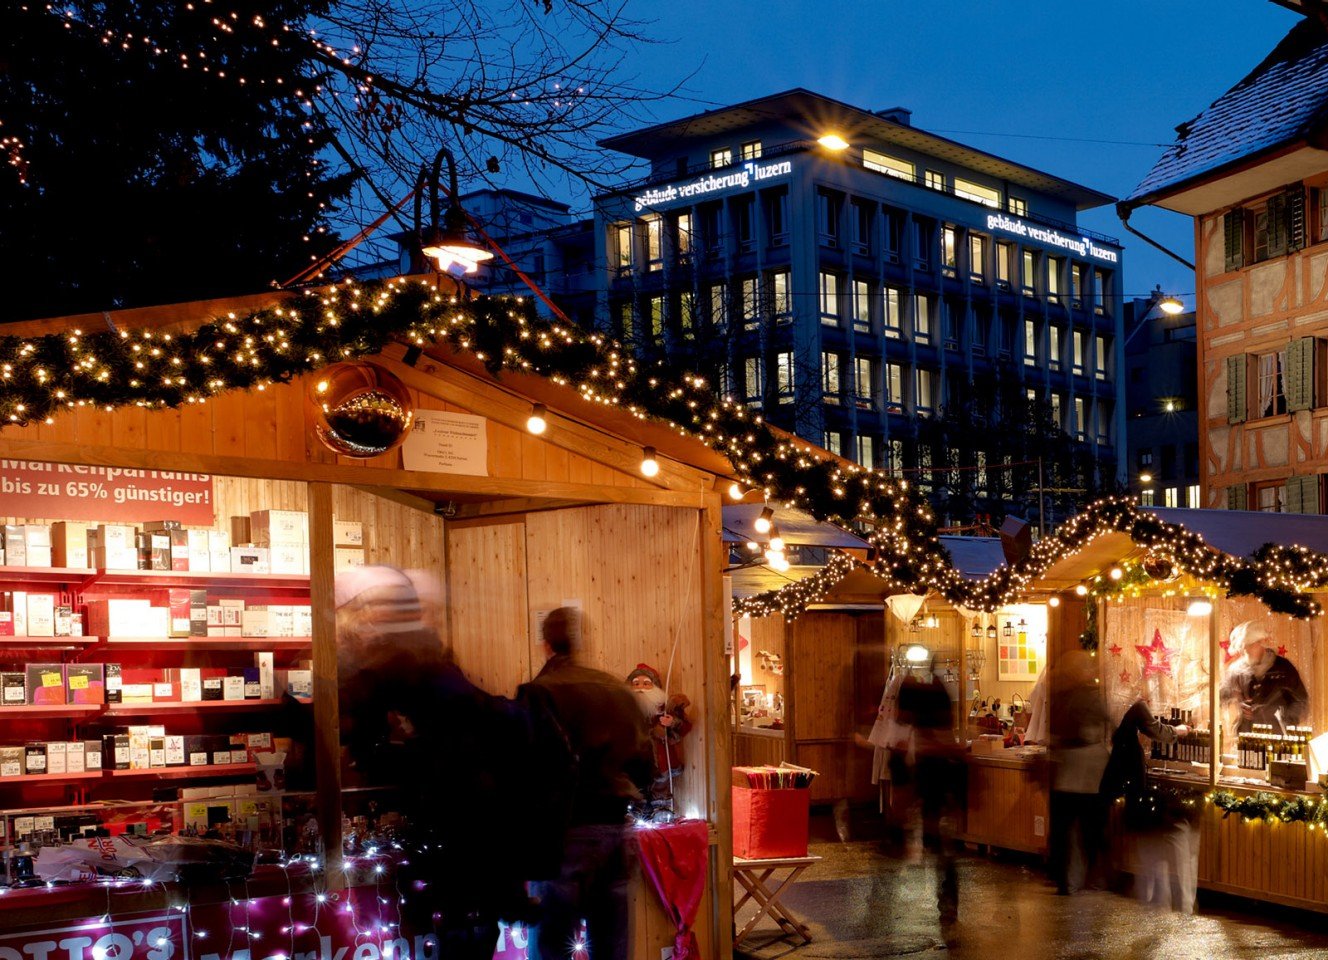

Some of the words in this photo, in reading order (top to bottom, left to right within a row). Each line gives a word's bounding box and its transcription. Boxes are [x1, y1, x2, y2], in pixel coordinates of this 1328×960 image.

[635, 185, 677, 211] gebäude
[678, 171, 749, 198] versicherung
[754, 161, 791, 181] luzern
[987, 214, 1026, 235] gebäude
[1028, 227, 1086, 256] versicherung
[1090, 242, 1117, 262] luzern
[2, 477, 31, 493] bis
[37, 483, 60, 495] zu
[66, 481, 108, 498] 65%
[114, 484, 209, 506] günstiger!
[0, 926, 175, 960] TTO'S
